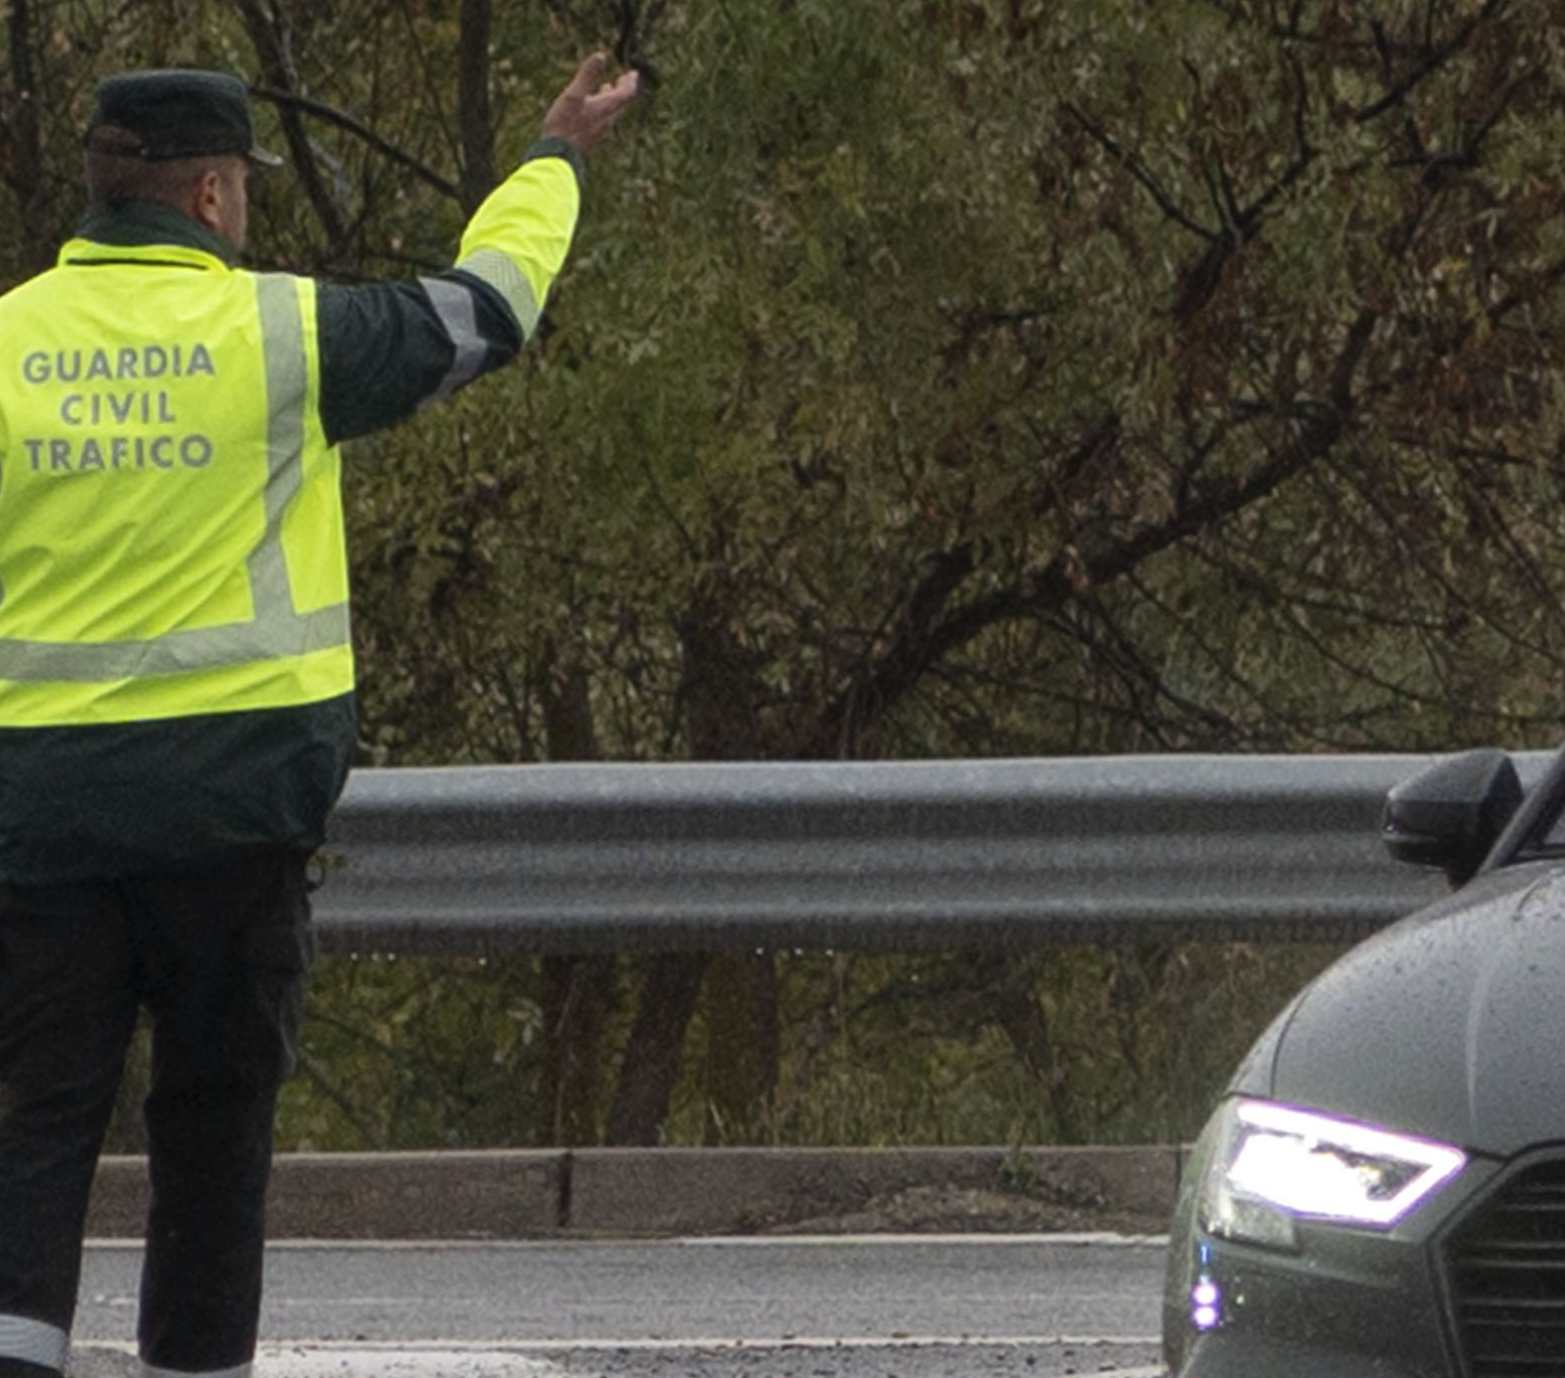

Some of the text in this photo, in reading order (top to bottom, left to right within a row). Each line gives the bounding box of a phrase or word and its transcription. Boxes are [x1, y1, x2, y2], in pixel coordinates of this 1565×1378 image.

[23, 343, 215, 384] GUARDIA
[61, 391, 175, 425] CIVIL
[23, 434, 213, 471] TRAFICO
